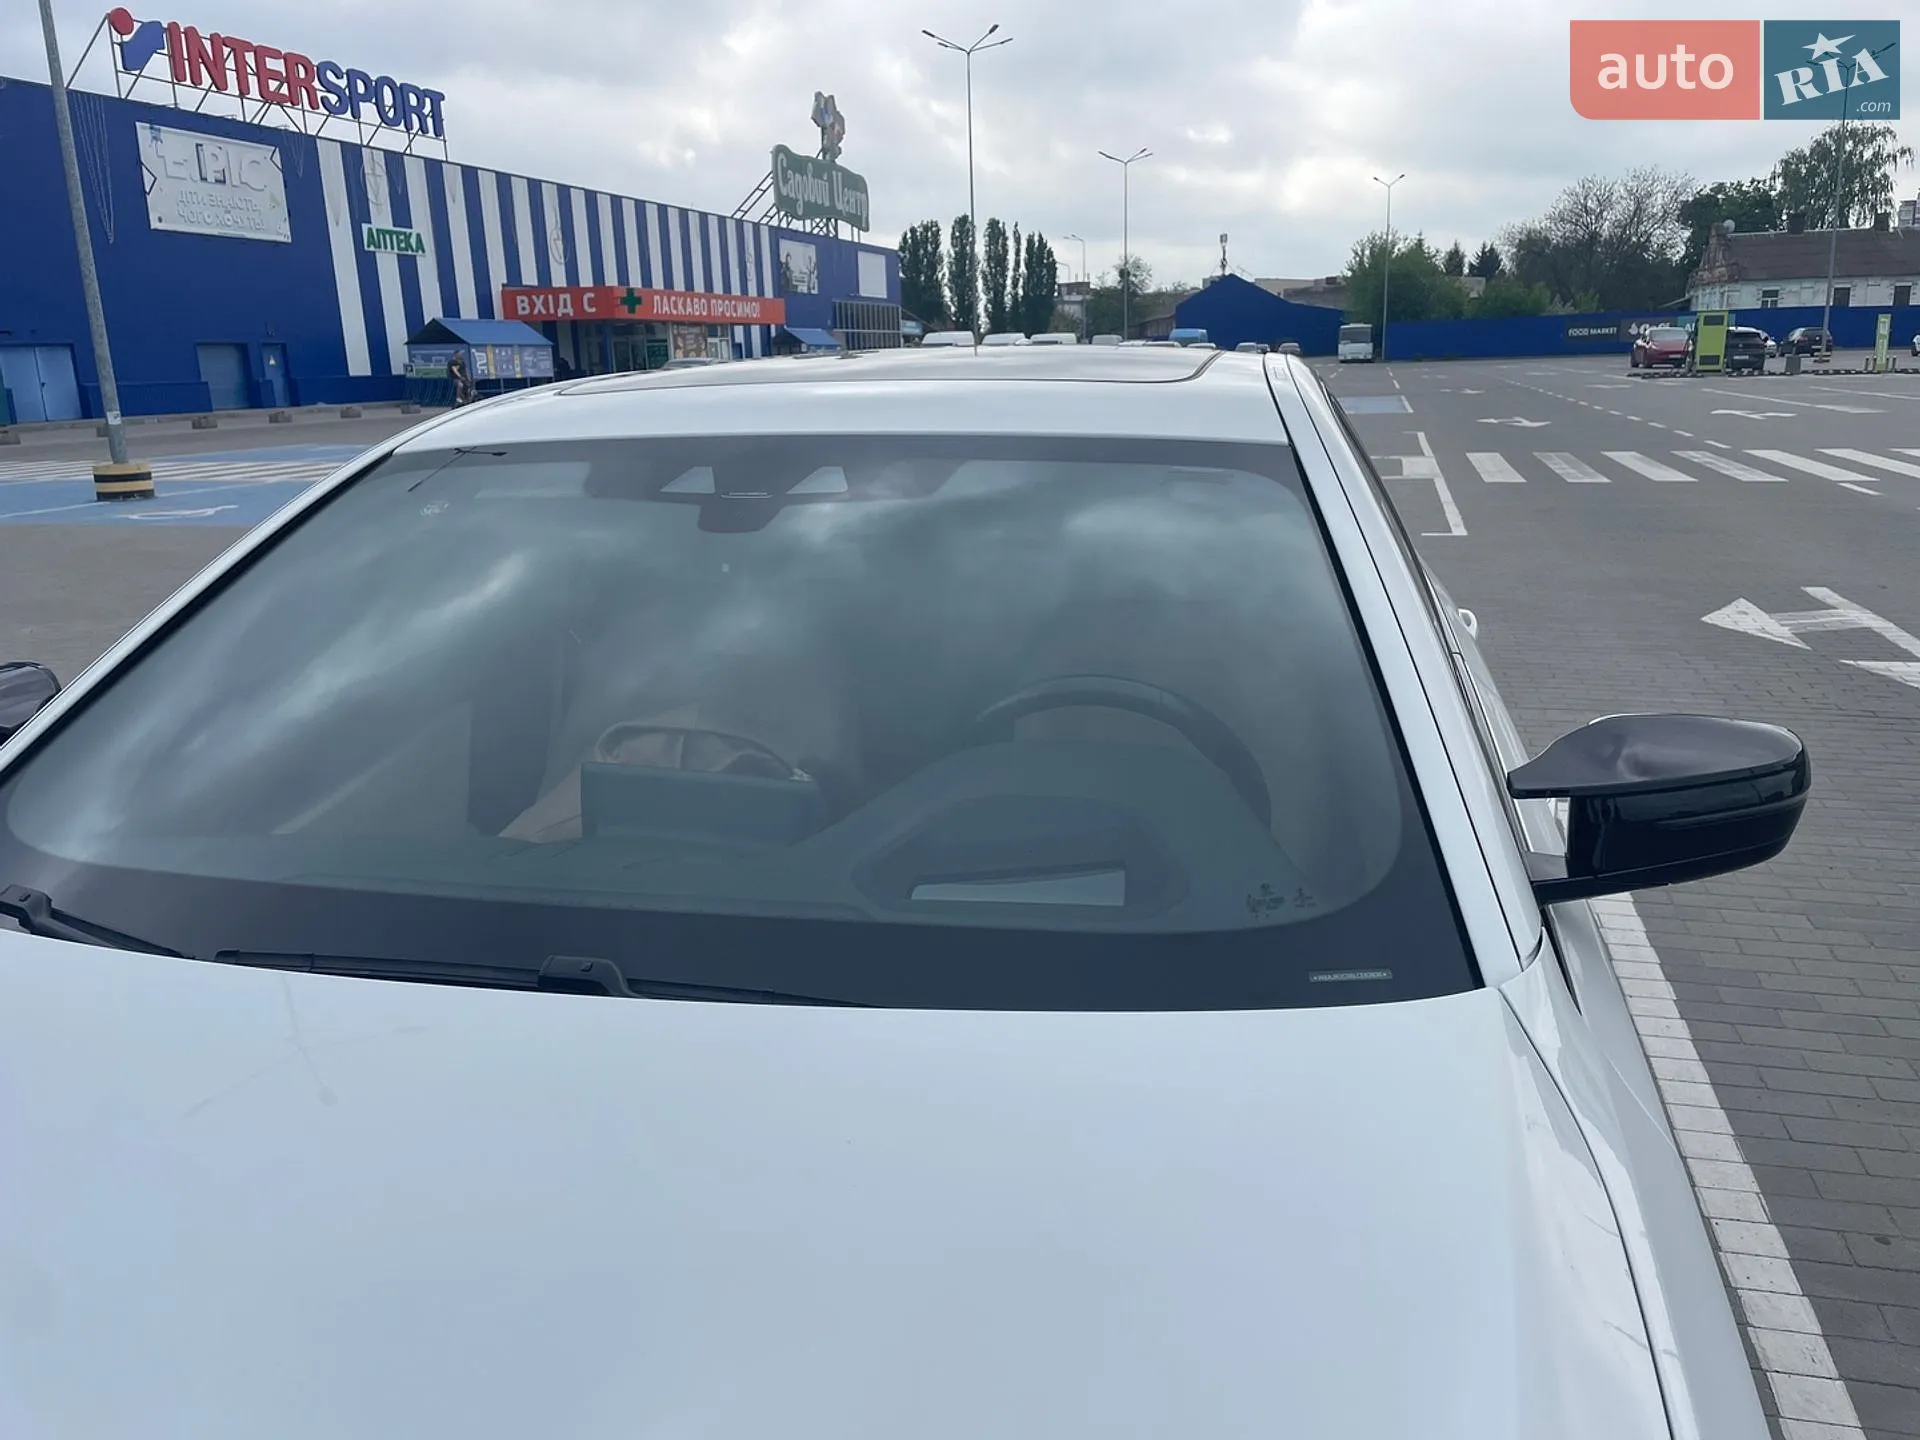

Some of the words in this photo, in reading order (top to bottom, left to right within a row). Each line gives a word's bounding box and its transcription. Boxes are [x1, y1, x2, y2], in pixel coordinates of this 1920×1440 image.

[167, 21, 446, 137] INTERSPORT
[366, 227, 426, 254] АПТЕКА
[516, 294, 574, 317] ВХІД
[653, 295, 707, 316] ЛАСКАВО
[711, 300, 760, 318] ПРОСИМО!
[1590, 326, 1618, 336] MARKET
